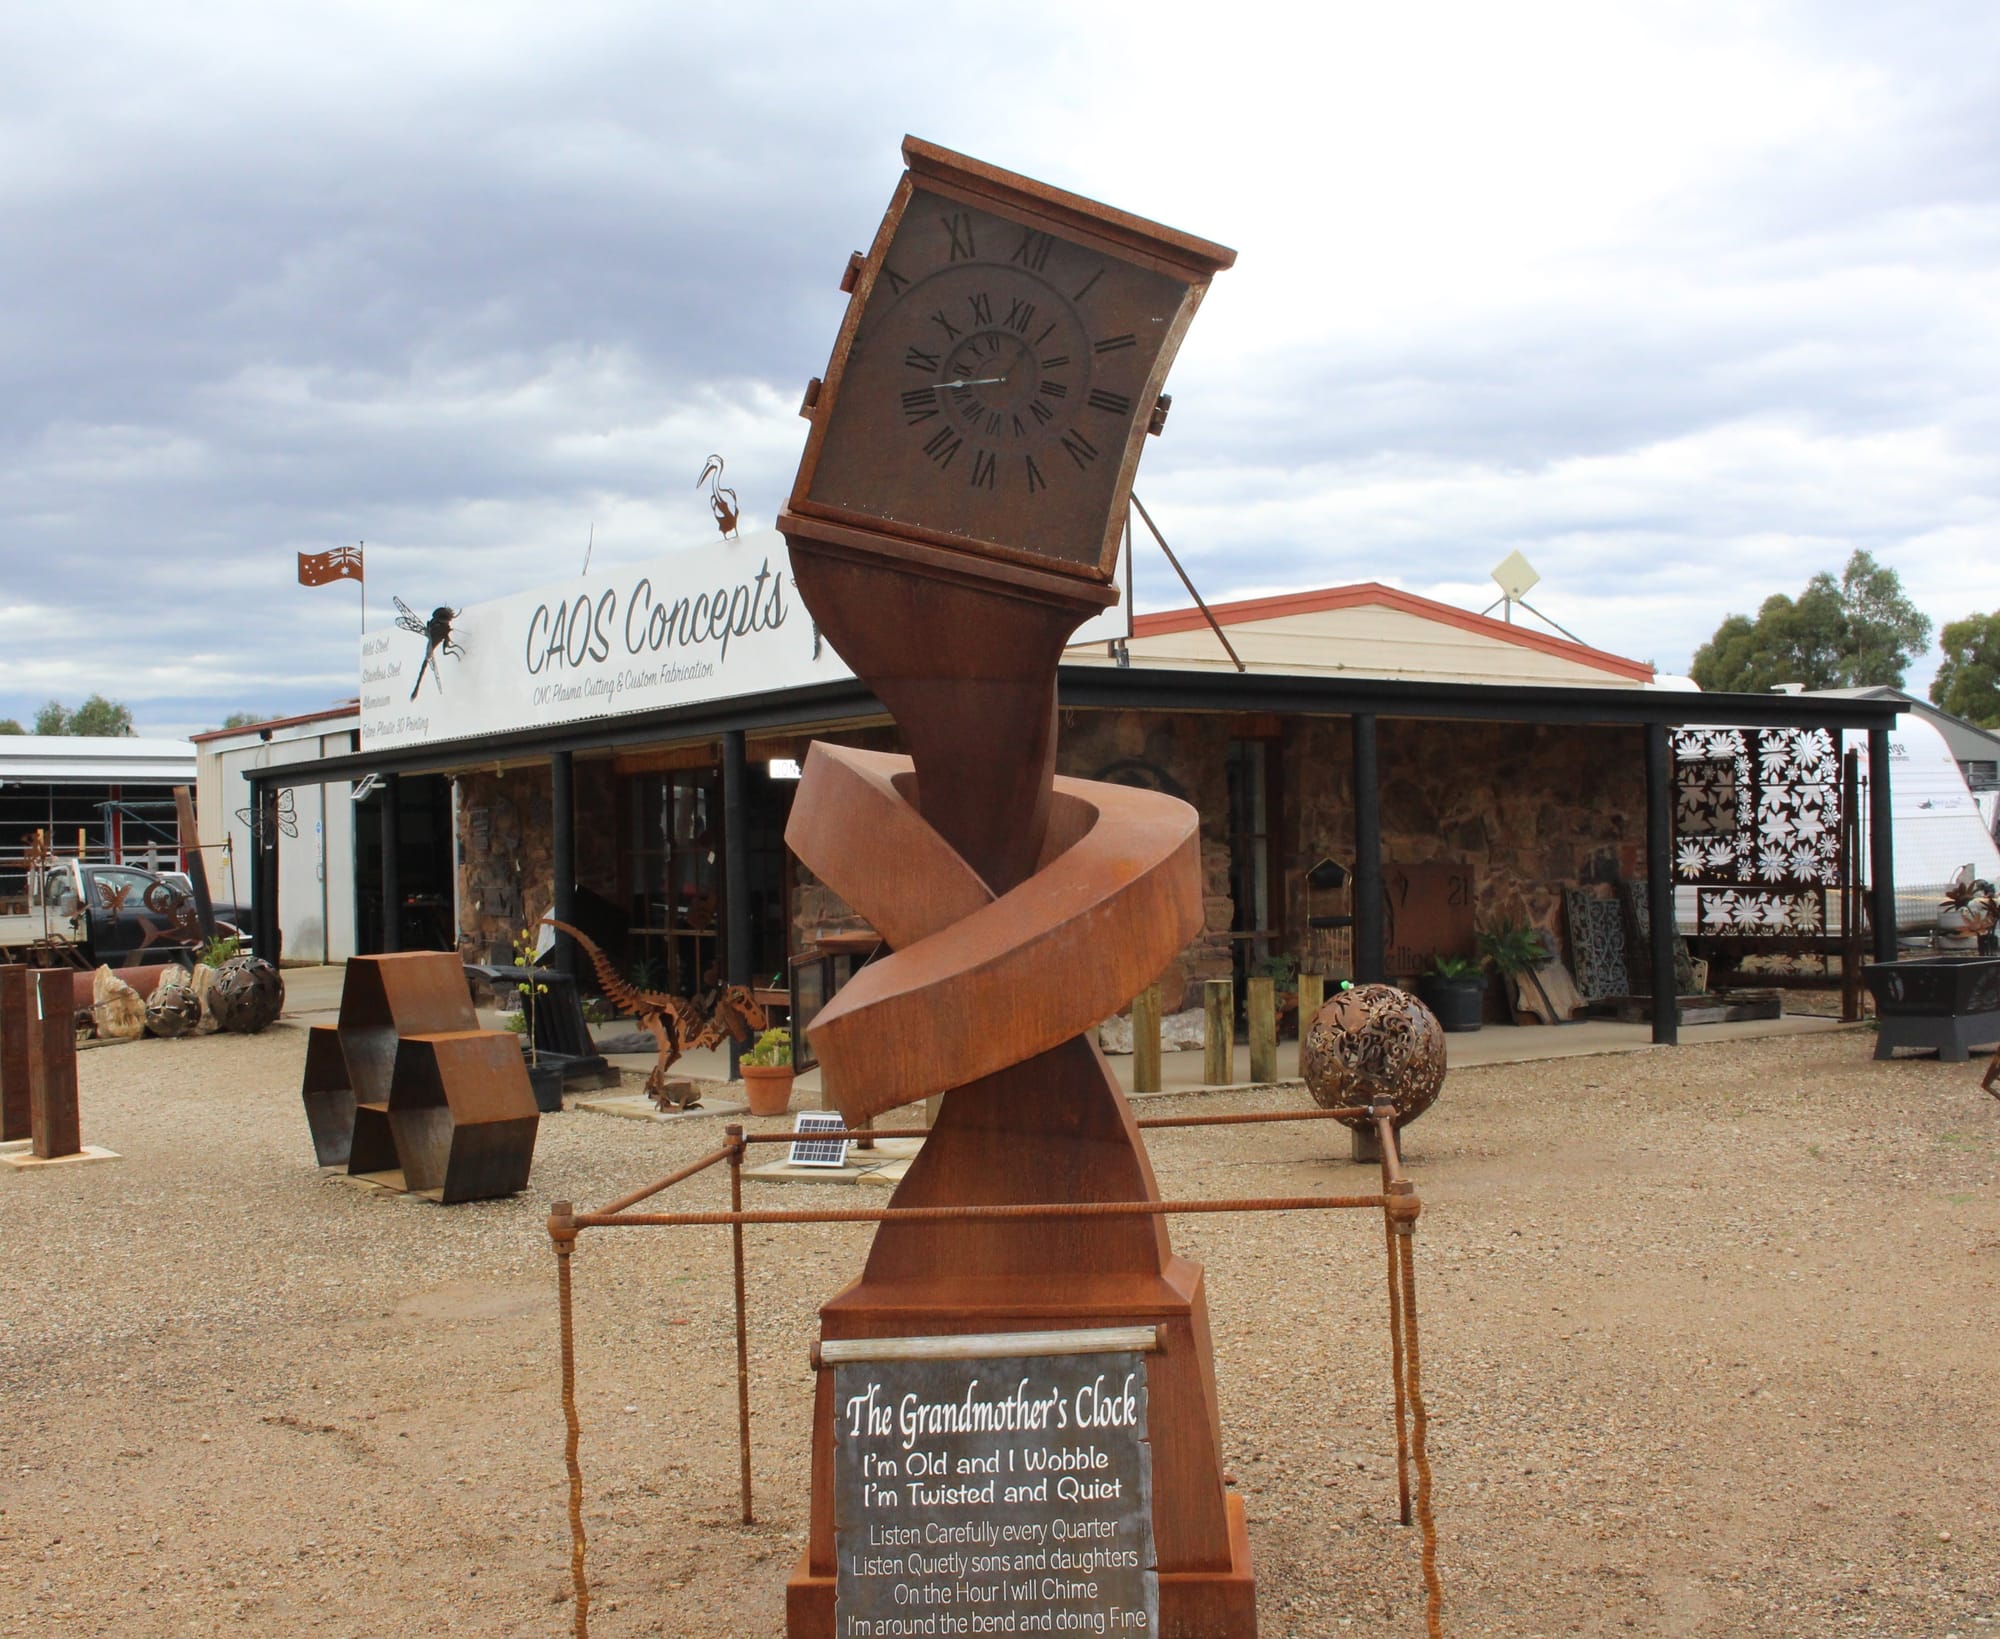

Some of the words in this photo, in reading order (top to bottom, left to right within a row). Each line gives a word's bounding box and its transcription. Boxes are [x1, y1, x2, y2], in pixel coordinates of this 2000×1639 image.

[942, 212, 976, 262] XI
[968, 293, 993, 326] XI
[1003, 298, 1036, 333] XII
[526, 588, 616, 675] CAOS
[625, 556, 789, 665] Concepts
[533, 684, 552, 706] CNC
[552, 683, 582, 704] Plasma
[584, 677, 615, 704] Cutting
[616, 671, 624, 693] &
[624, 669, 658, 691] Custom
[660, 661, 714, 686] Fabrication
[847, 1382, 893, 1437] The
[899, 1377, 1068, 1450] Grandmother's
[1074, 1373, 1137, 1429] Clock
[863, 1453, 898, 1478] I'm
[905, 1450, 948, 1477] Old
[956, 1449, 1000, 1476] and
[1008, 1448, 1015, 1473] I
[1024, 1445, 1109, 1473] Wobble
[863, 1483, 898, 1508] I'm
[906, 1479, 995, 1507] Twisted
[1003, 1477, 1048, 1505] and
[1057, 1476, 1123, 1504] Quiet
[869, 1522, 921, 1547] Listen
[925, 1519, 1000, 1548] Carefully
[1002, 1522, 1048, 1547] every
[1051, 1516, 1119, 1543] Quarter
[852, 1552, 904, 1577] Listen
[907, 1549, 969, 1578] Quietly
[971, 1554, 1011, 1573] sons
[1013, 1548, 1047, 1572] and
[1050, 1546, 1139, 1574] daughters
[894, 1583, 921, 1605] On
[922, 1581, 952, 1604] the
[955, 1581, 1000, 1604] Hour
[1002, 1580, 1008, 1602] I
[1010, 1579, 1038, 1602] will
[1041, 1577, 1099, 1601] Chime
[847, 1615, 872, 1637] I'm
[873, 1612, 936, 1636] around
[938, 1611, 969, 1634] the
[971, 1610, 1017, 1633] bend
[1019, 1608, 1052, 1631] and
[1055, 1607, 1106, 1635] doing
[1109, 1606, 1148, 1629] Fine
